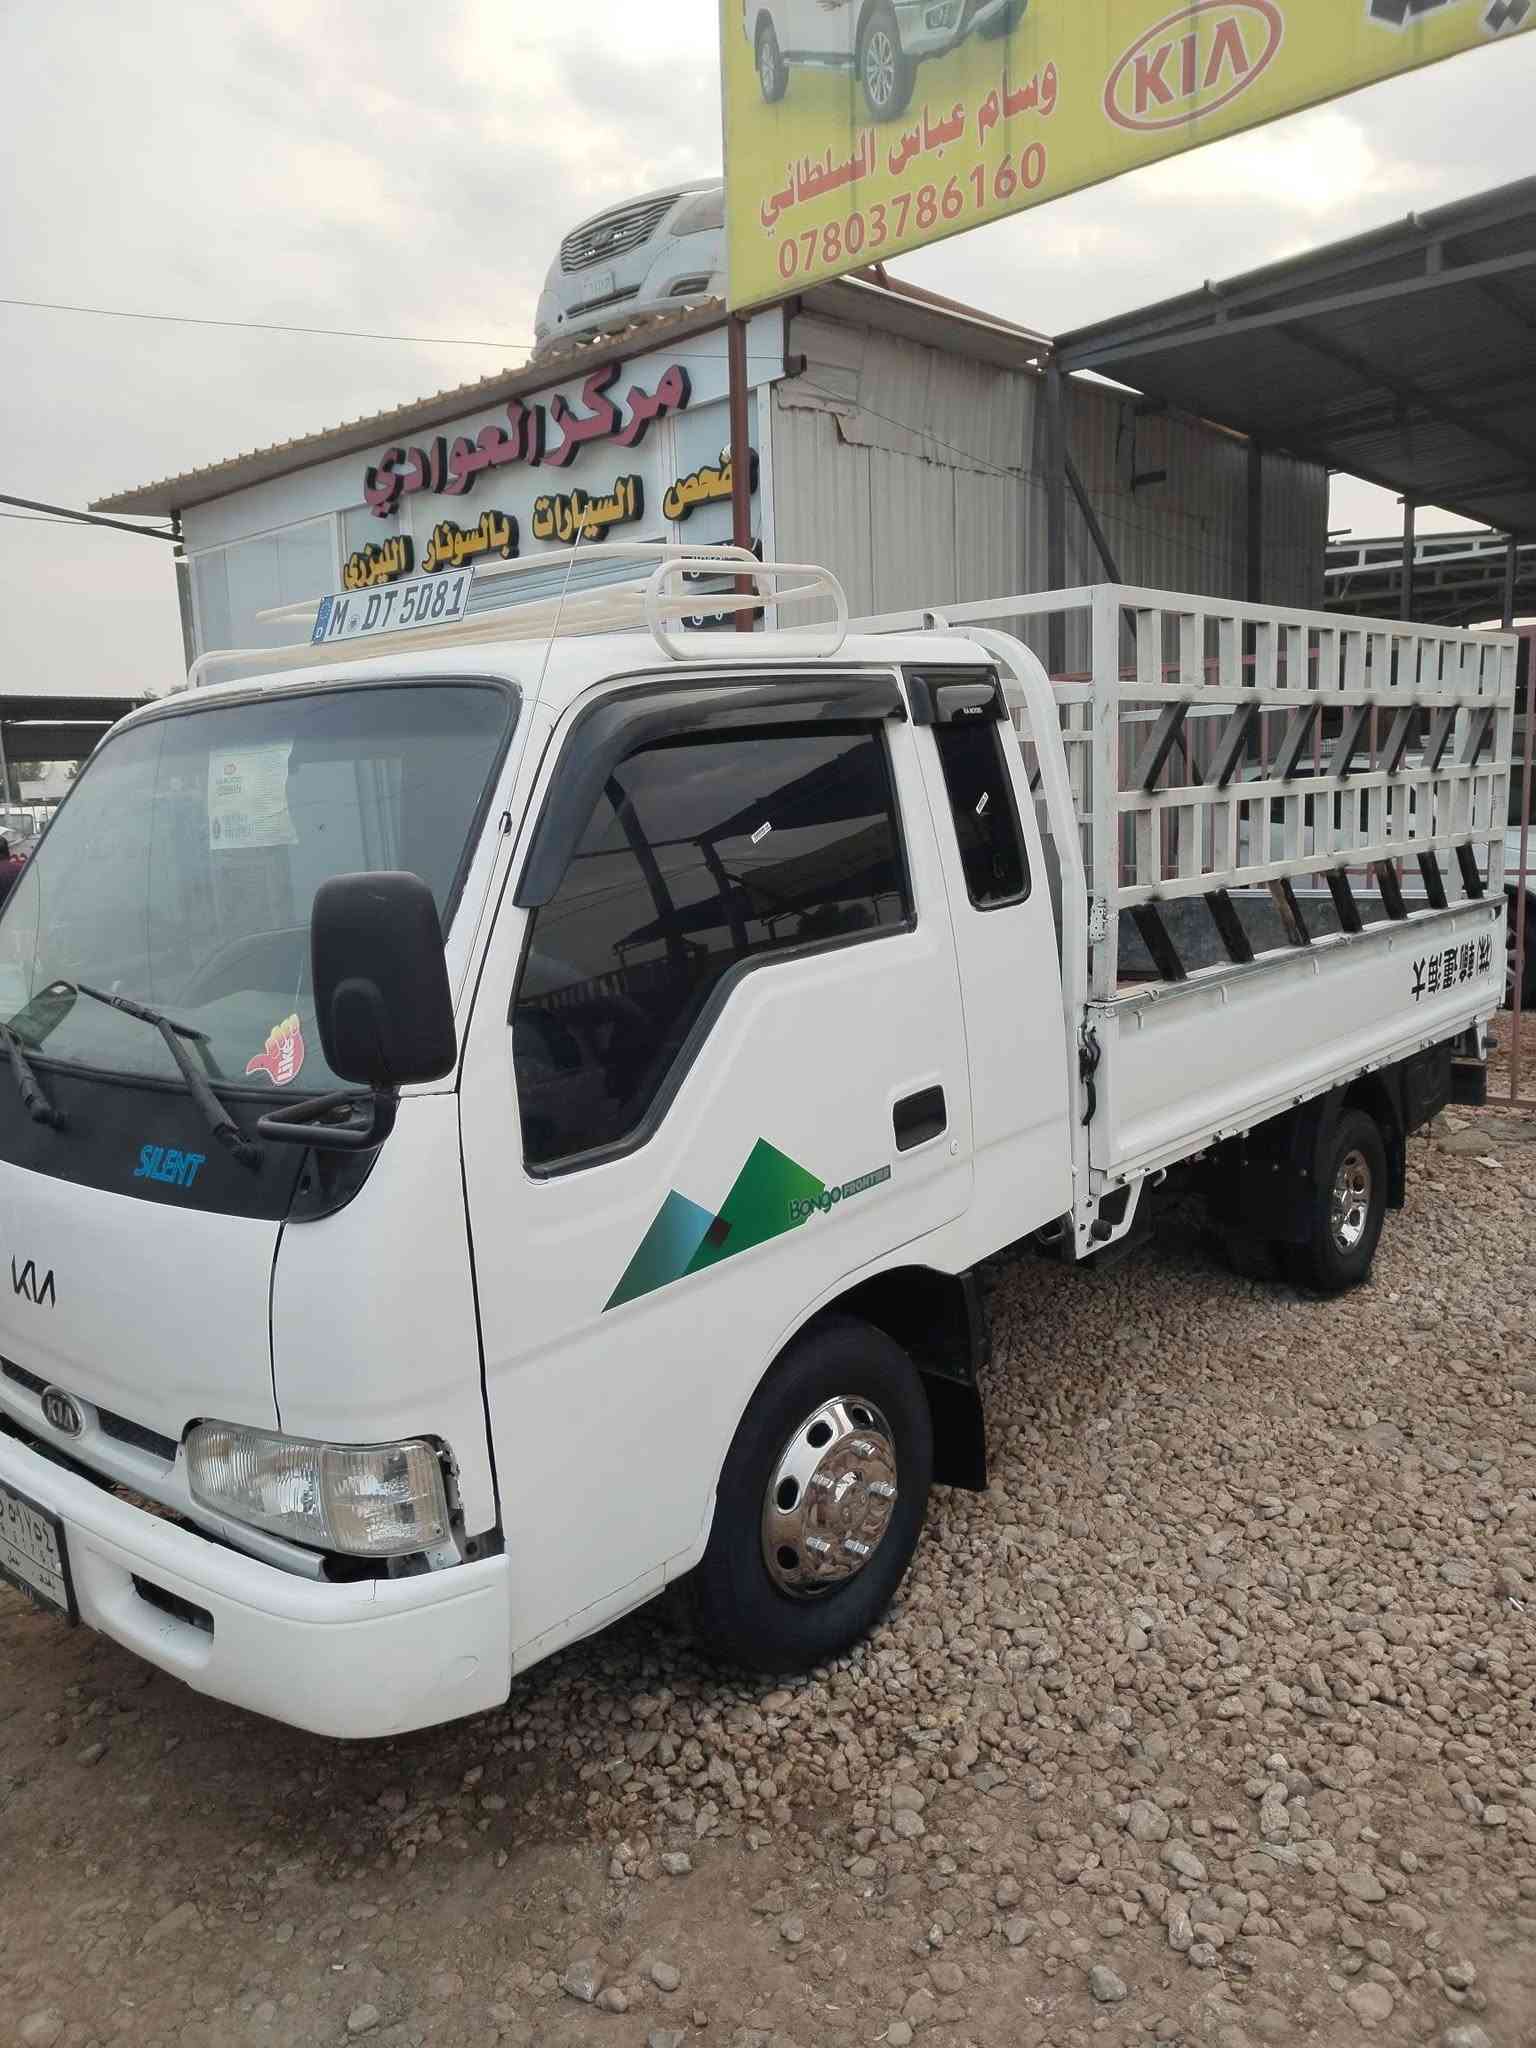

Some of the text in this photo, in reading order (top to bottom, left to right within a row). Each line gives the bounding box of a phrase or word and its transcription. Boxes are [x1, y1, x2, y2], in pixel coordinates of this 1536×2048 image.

[1132, 18, 1249, 116] KIA
[760, 62, 1058, 236] وسام عباس السلطاني
[777, 143, 1046, 278] 07803786160
[365, 362, 691, 518] مركز العوادي
[422, 510, 518, 572] بالسونار
[533, 474, 644, 544] السيارات
[329, 577, 465, 635] M DT 5081
[134, 1144, 206, 1187] SILENT
[46, 1399, 77, 1430] KIA
